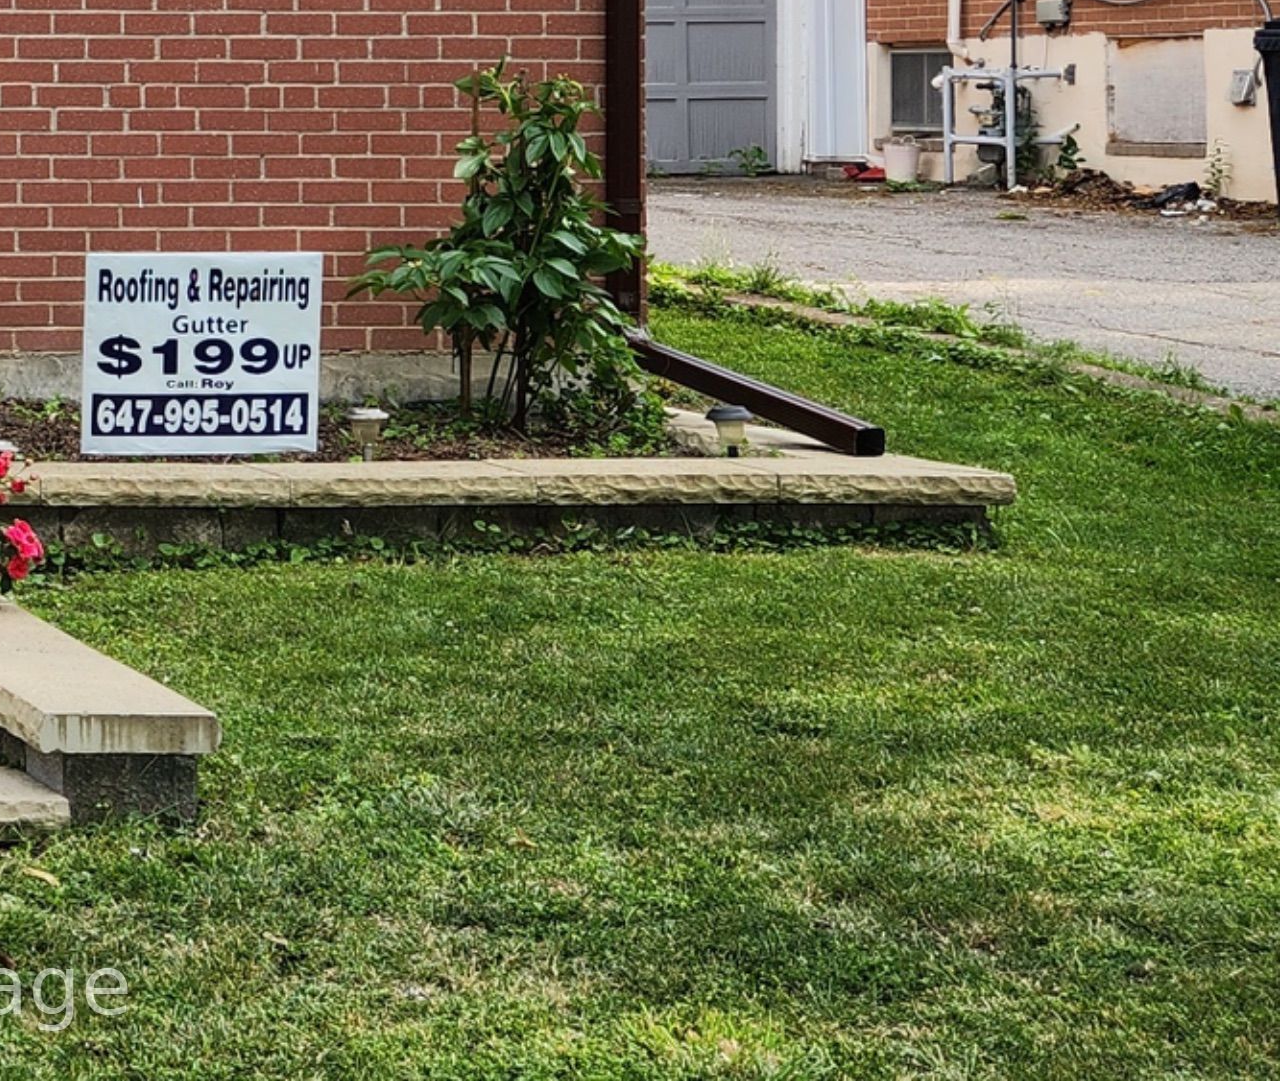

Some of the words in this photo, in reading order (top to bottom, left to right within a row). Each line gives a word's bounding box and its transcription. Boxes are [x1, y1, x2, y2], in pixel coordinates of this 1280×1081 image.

[98, 268, 179, 310] Roofing
[186, 268, 201, 303] &
[207, 268, 310, 310] Repairing
[172, 315, 249, 334] Gutter
[97, 334, 280, 379] $199
[283, 344, 311, 369] UP
[166, 379, 199, 389] Call:
[201, 378, 234, 390] Roy
[96, 398, 304, 434] 647-995-0514
